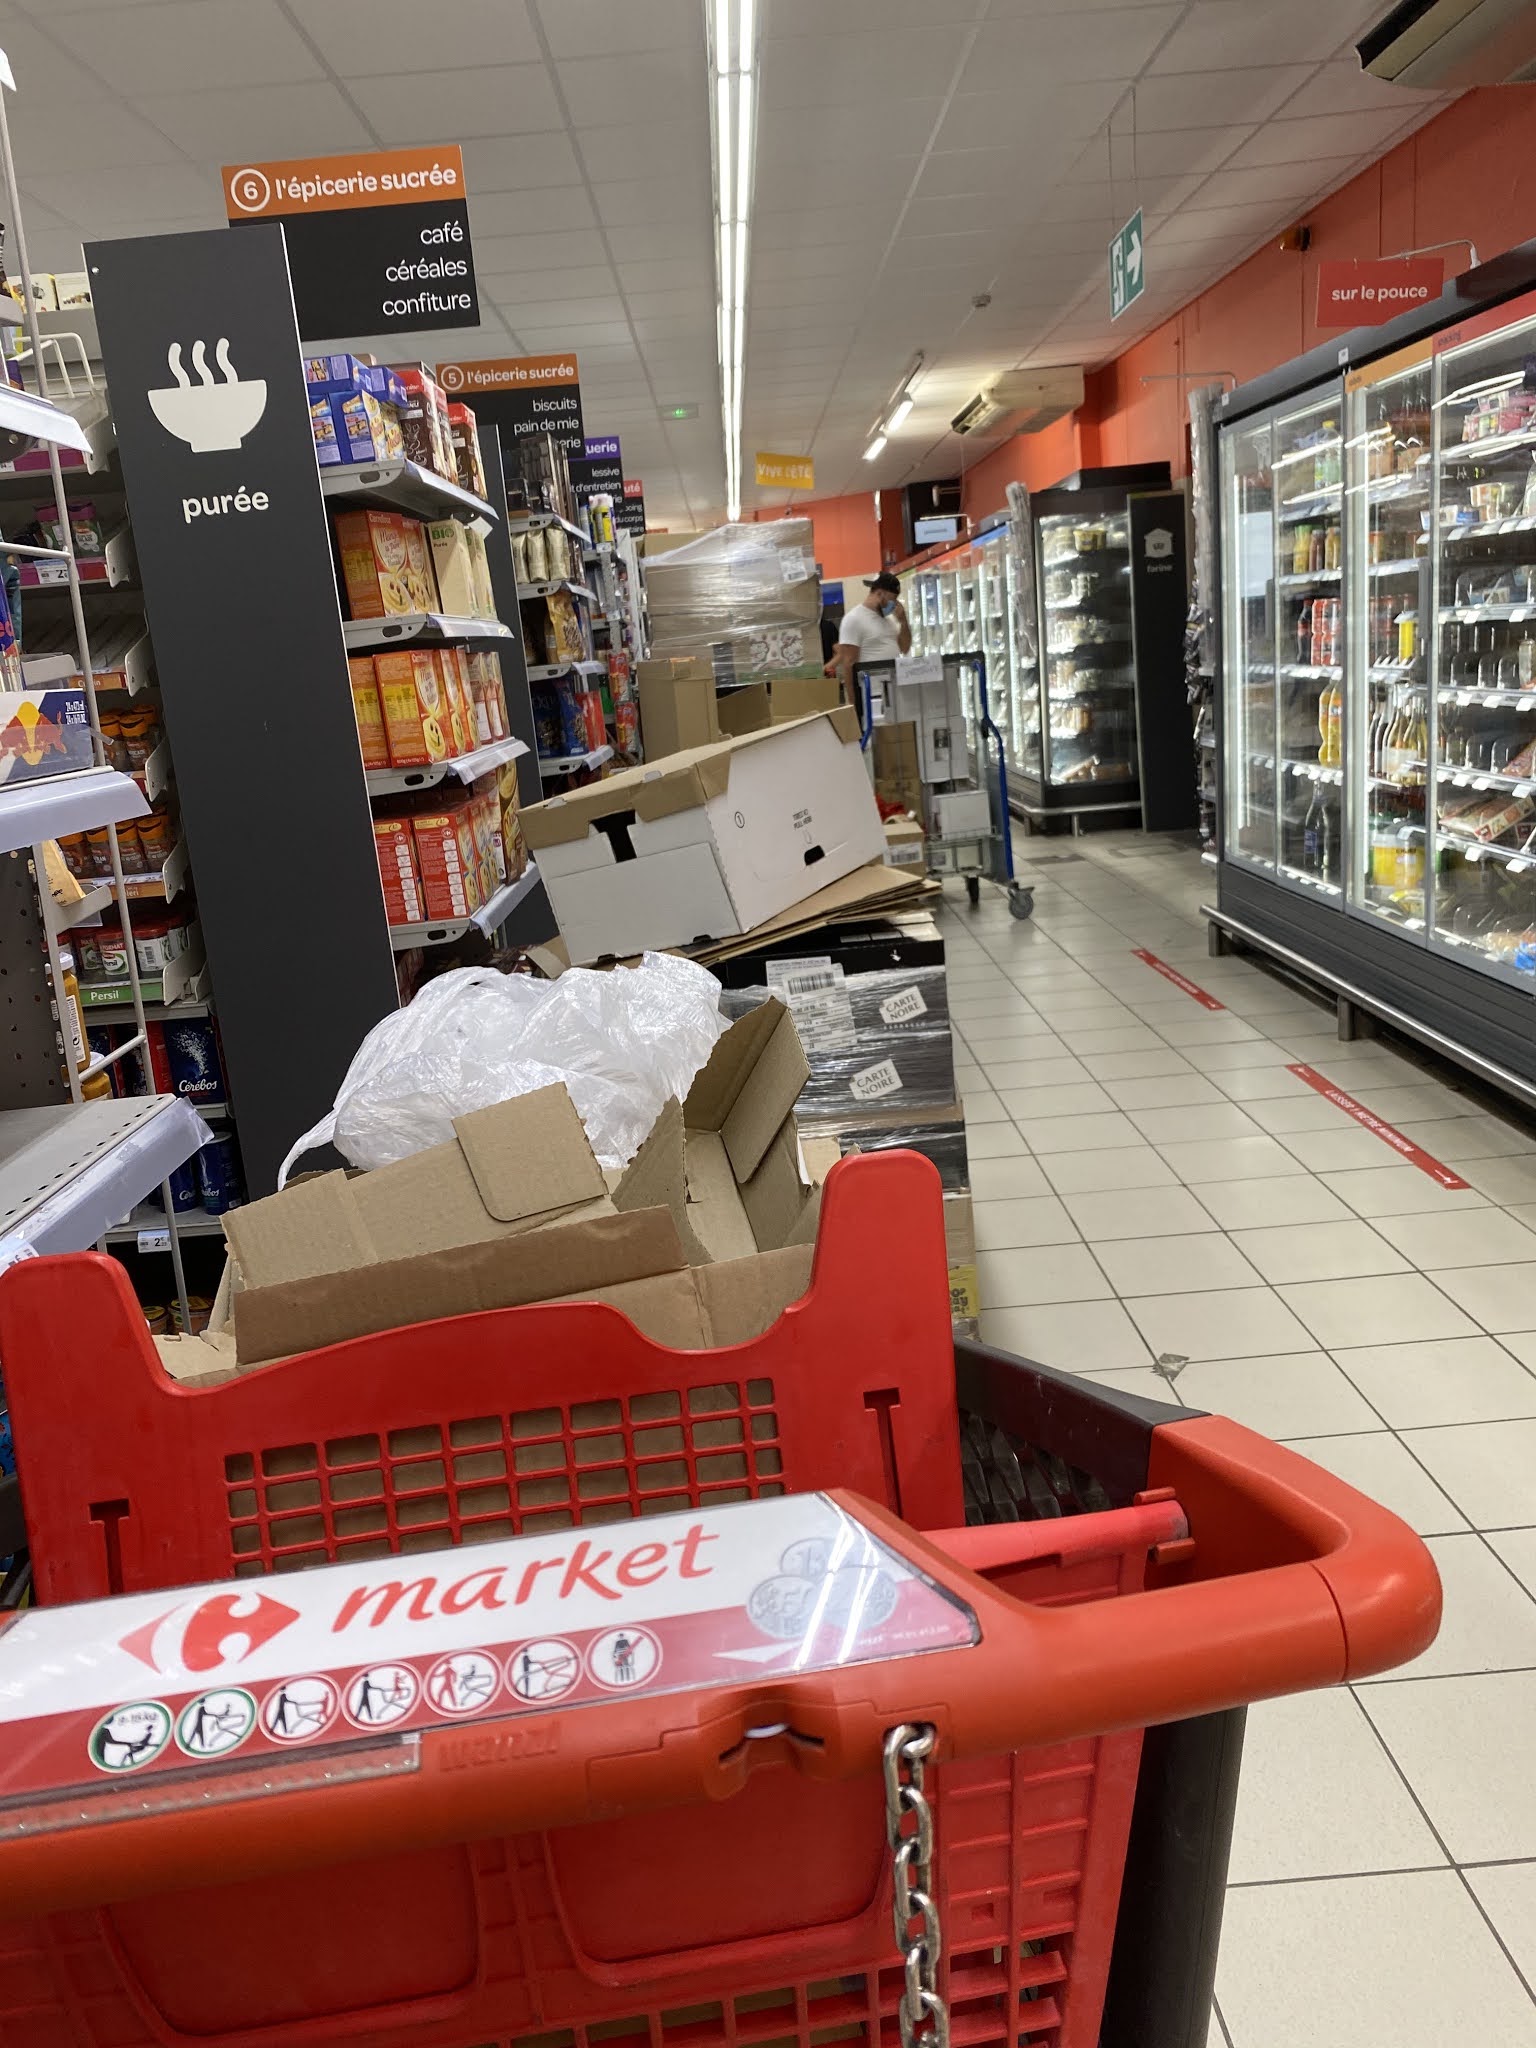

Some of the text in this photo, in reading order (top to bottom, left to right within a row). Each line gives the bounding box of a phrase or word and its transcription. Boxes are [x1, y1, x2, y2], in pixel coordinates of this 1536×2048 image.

[243, 163, 457, 203] 6 l'épicerie sucrée
[420, 220, 464, 245] café
[385, 256, 468, 283] céréales
[382, 291, 471, 316] confiture
[1331, 285, 1428, 303] sur le pouce
[448, 363, 574, 386] 5 l'épicerie sucrée
[532, 398, 578, 412] biscuits
[513, 418, 579, 436] pain de mie
[591, 467, 620, 477] lessive
[576, 482, 622, 493] d'entretien
[623, 481, 640, 493] uté
[182, 485, 270, 524] purée
[431, 528, 455, 540] BIO
[90, 990, 120, 1001] Persil
[886, 993, 916, 1013] CARTE
[889, 1002, 921, 1020] NOIRE
[179, 1078, 218, 1093] Cérébos
[856, 1066, 892, 1088] CARTE
[861, 1075, 896, 1097] NOIRE
[330, 1523, 721, 1634] market
